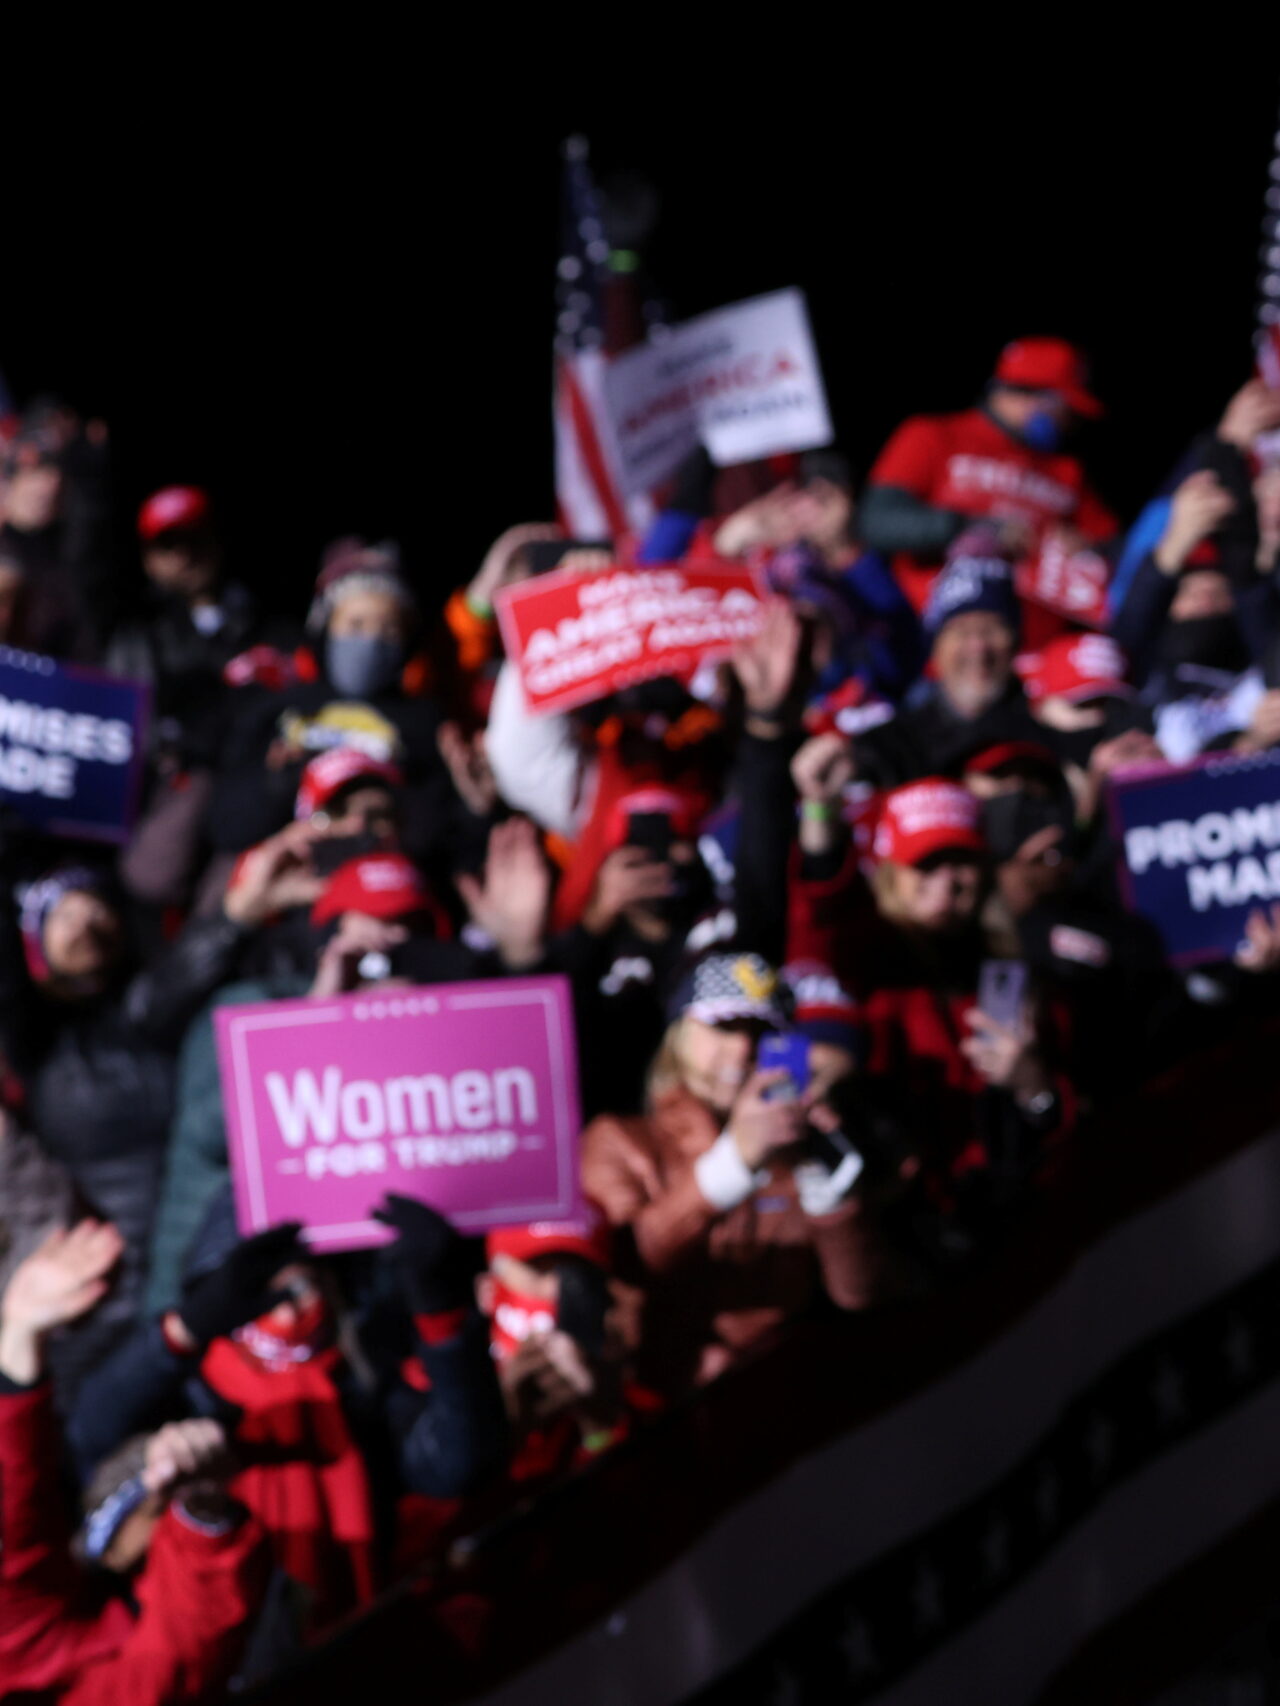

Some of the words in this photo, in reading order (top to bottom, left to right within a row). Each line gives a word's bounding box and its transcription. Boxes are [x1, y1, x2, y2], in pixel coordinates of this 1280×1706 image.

[525, 586, 759, 665] AMERICA
[265, 1065, 539, 1148] Women
[304, 1141, 387, 1170] FOR
[390, 1129, 518, 1169] TRUMP
